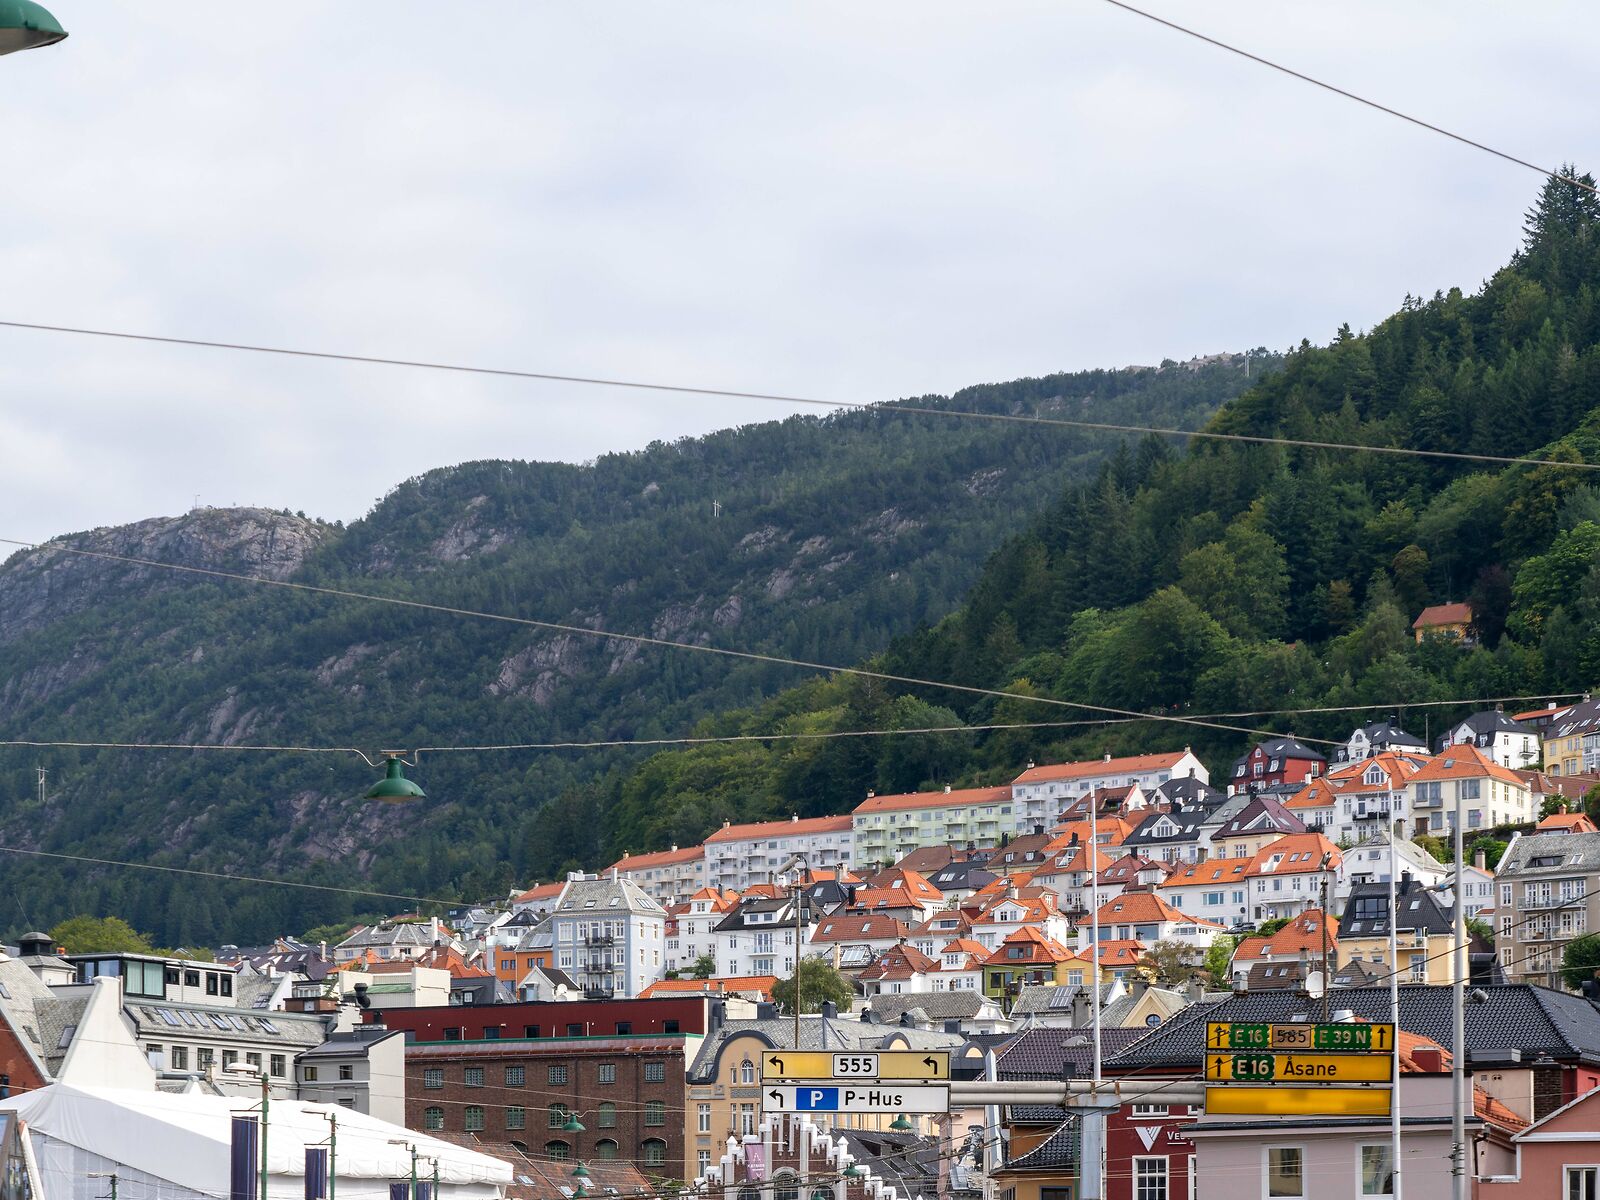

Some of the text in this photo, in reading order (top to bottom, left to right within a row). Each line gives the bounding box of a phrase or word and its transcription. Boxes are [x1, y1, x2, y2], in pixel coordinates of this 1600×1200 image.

[1234, 1030, 1244, 1043] E
[1249, 1030, 1263, 1043] 16
[1319, 1031, 1328, 1044] E
[1333, 1031, 1351, 1044] 39
[1355, 1031, 1367, 1044] N
[839, 1058, 873, 1073] 555
[1236, 1055, 1337, 1076] E 16 Åsane
[844, 1090, 903, 1106] P-Hus
